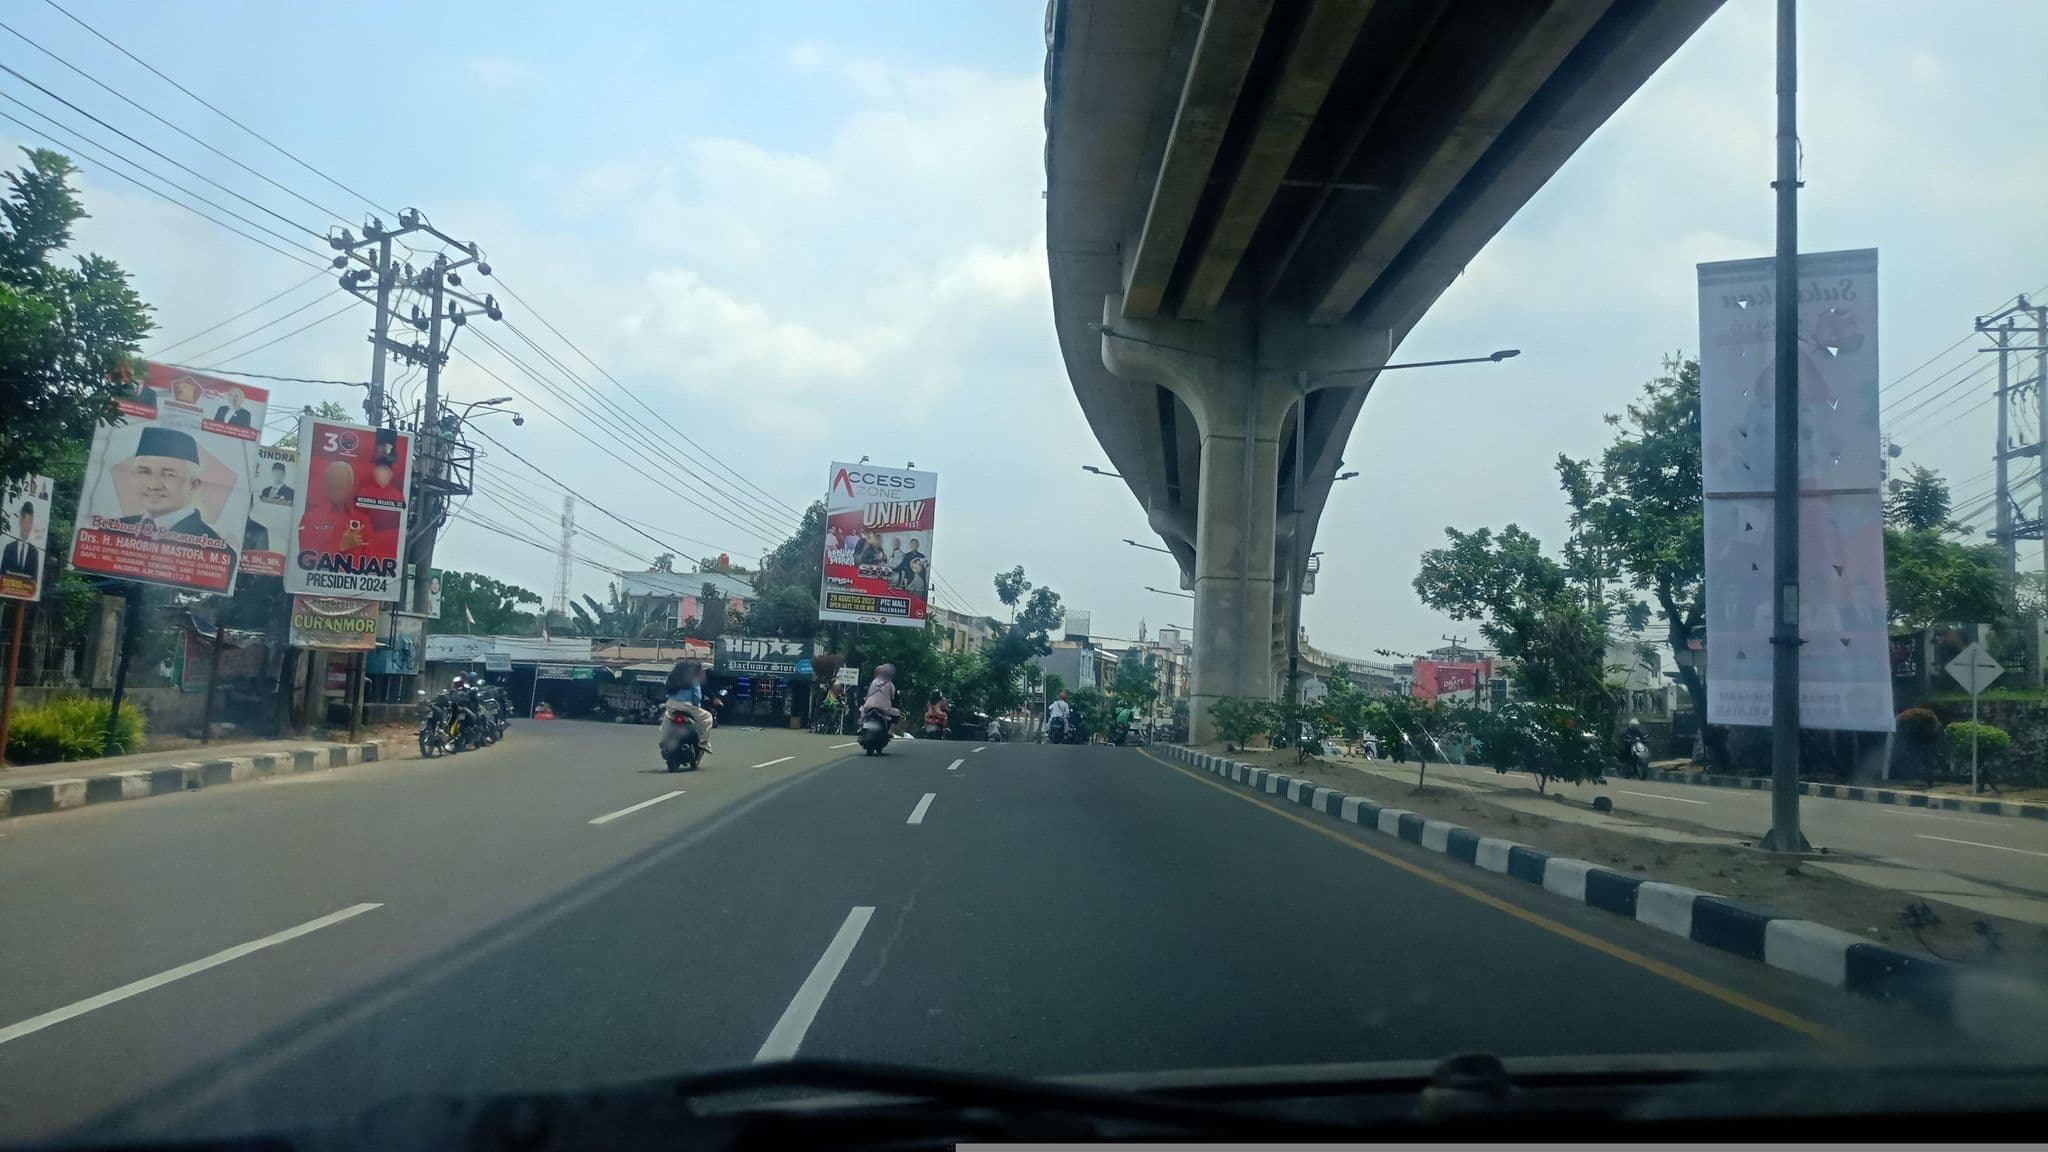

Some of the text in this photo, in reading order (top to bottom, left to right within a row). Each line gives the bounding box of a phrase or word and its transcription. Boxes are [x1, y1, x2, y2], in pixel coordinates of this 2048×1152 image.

[833, 468, 916, 498] ACCESS
[855, 485, 902, 499] ZONE
[863, 501, 926, 529] UNITY
[80, 530, 99, 544] Drs.
[102, 534, 113, 546] H.
[116, 537, 159, 553] HAROBIN
[297, 551, 398, 578] GANJAR
[306, 572, 388, 592] PRESIDEN 2024
[293, 614, 376, 634] CURANMOR
